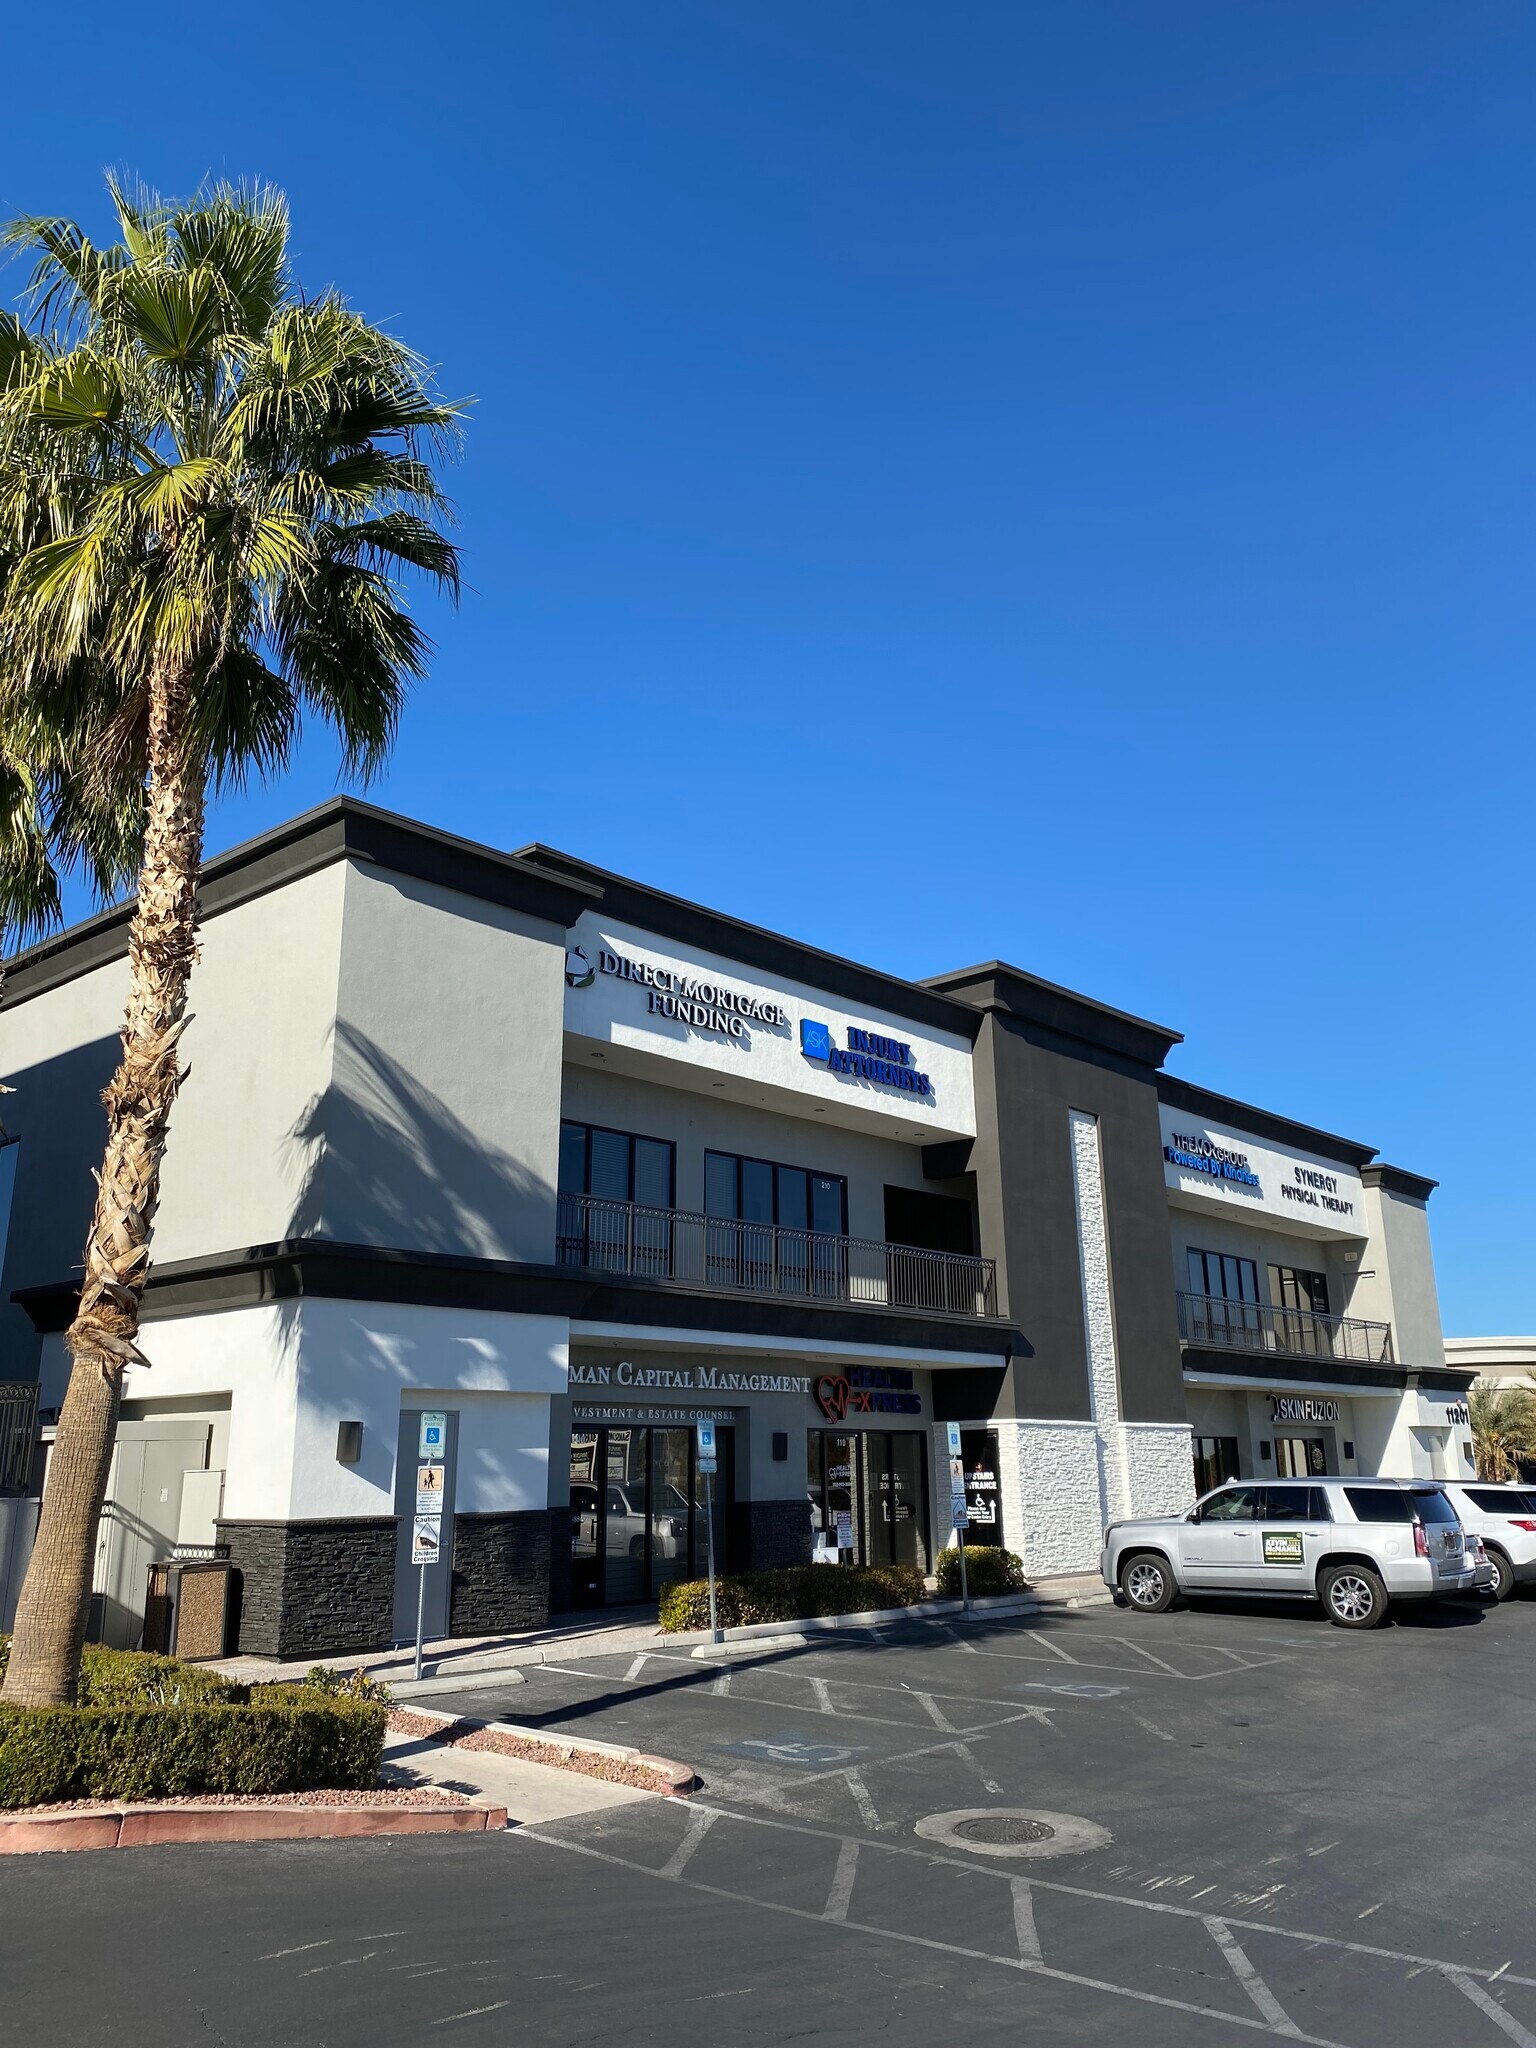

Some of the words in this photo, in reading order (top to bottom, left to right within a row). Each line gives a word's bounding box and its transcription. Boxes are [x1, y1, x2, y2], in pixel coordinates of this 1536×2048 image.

[600, 951, 679, 993] DIRECT
[681, 977, 785, 1026] MORTGAGE
[648, 992, 744, 1037] FUNDING
[847, 1026, 910, 1065] INJURY
[827, 1048, 930, 1095] ATTORNEYS
[1166, 1147, 1209, 1172] Powered
[1211, 1160, 1221, 1177] By
[1223, 1162, 1260, 1186] Kindness
[1294, 1167, 1337, 1194] SYNERGY
[1281, 1184, 1319, 1207] PHYSICAL
[1320, 1195, 1353, 1216] THERAPY
[569, 1366, 611, 1384] MAN
[573, 1407, 633, 1418] VESTMENT
[637, 1409, 644, 1419] &
[648, 1409, 686, 1420] ESTATE
[689, 1410, 735, 1420] COUNSEL
[1446, 1407, 1469, 1425] 11201
[965, 1472, 994, 1480] UPSTAIRS
